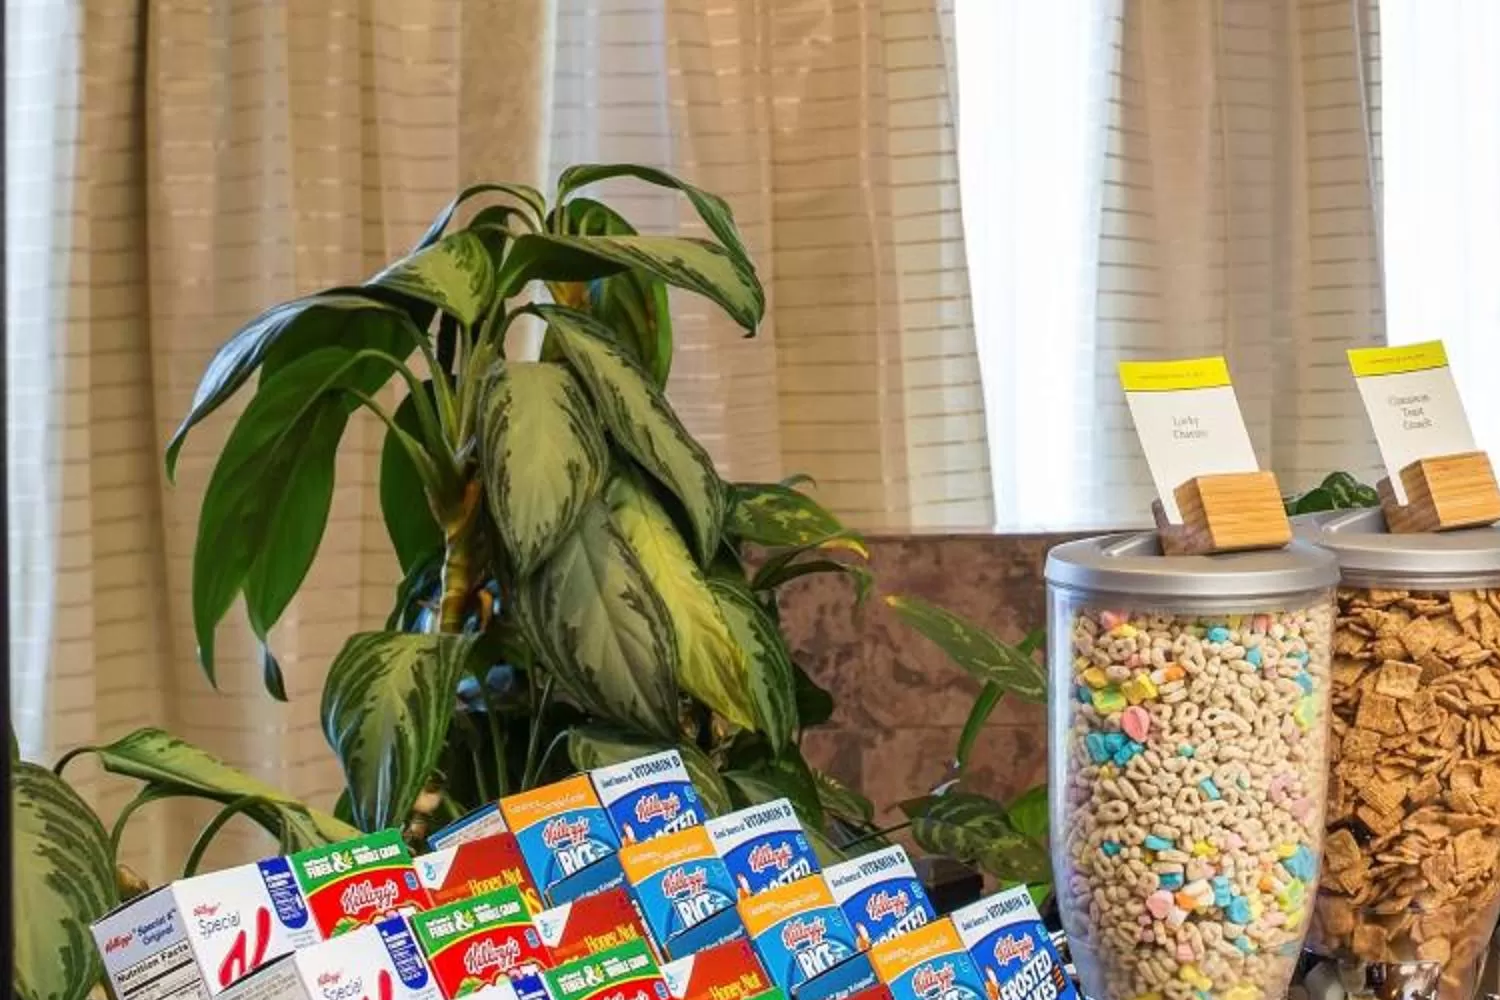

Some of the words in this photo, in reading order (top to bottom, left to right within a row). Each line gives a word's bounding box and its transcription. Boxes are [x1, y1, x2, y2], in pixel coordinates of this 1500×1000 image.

[632, 758, 672, 780] VITAMIN
[672, 755, 681, 768] D
[743, 806, 783, 829] VITAMIN
[782, 804, 792, 818] D
[859, 855, 898, 876] VITAMIN
[897, 851, 906, 864] D
[341, 880, 398, 915] Kellogg's
[199, 911, 241, 938] Special
[584, 932, 617, 953] Honey
[616, 923, 638, 940] Nut
[464, 936, 521, 975] Kellogg's
[740, 971, 763, 989] Nut
